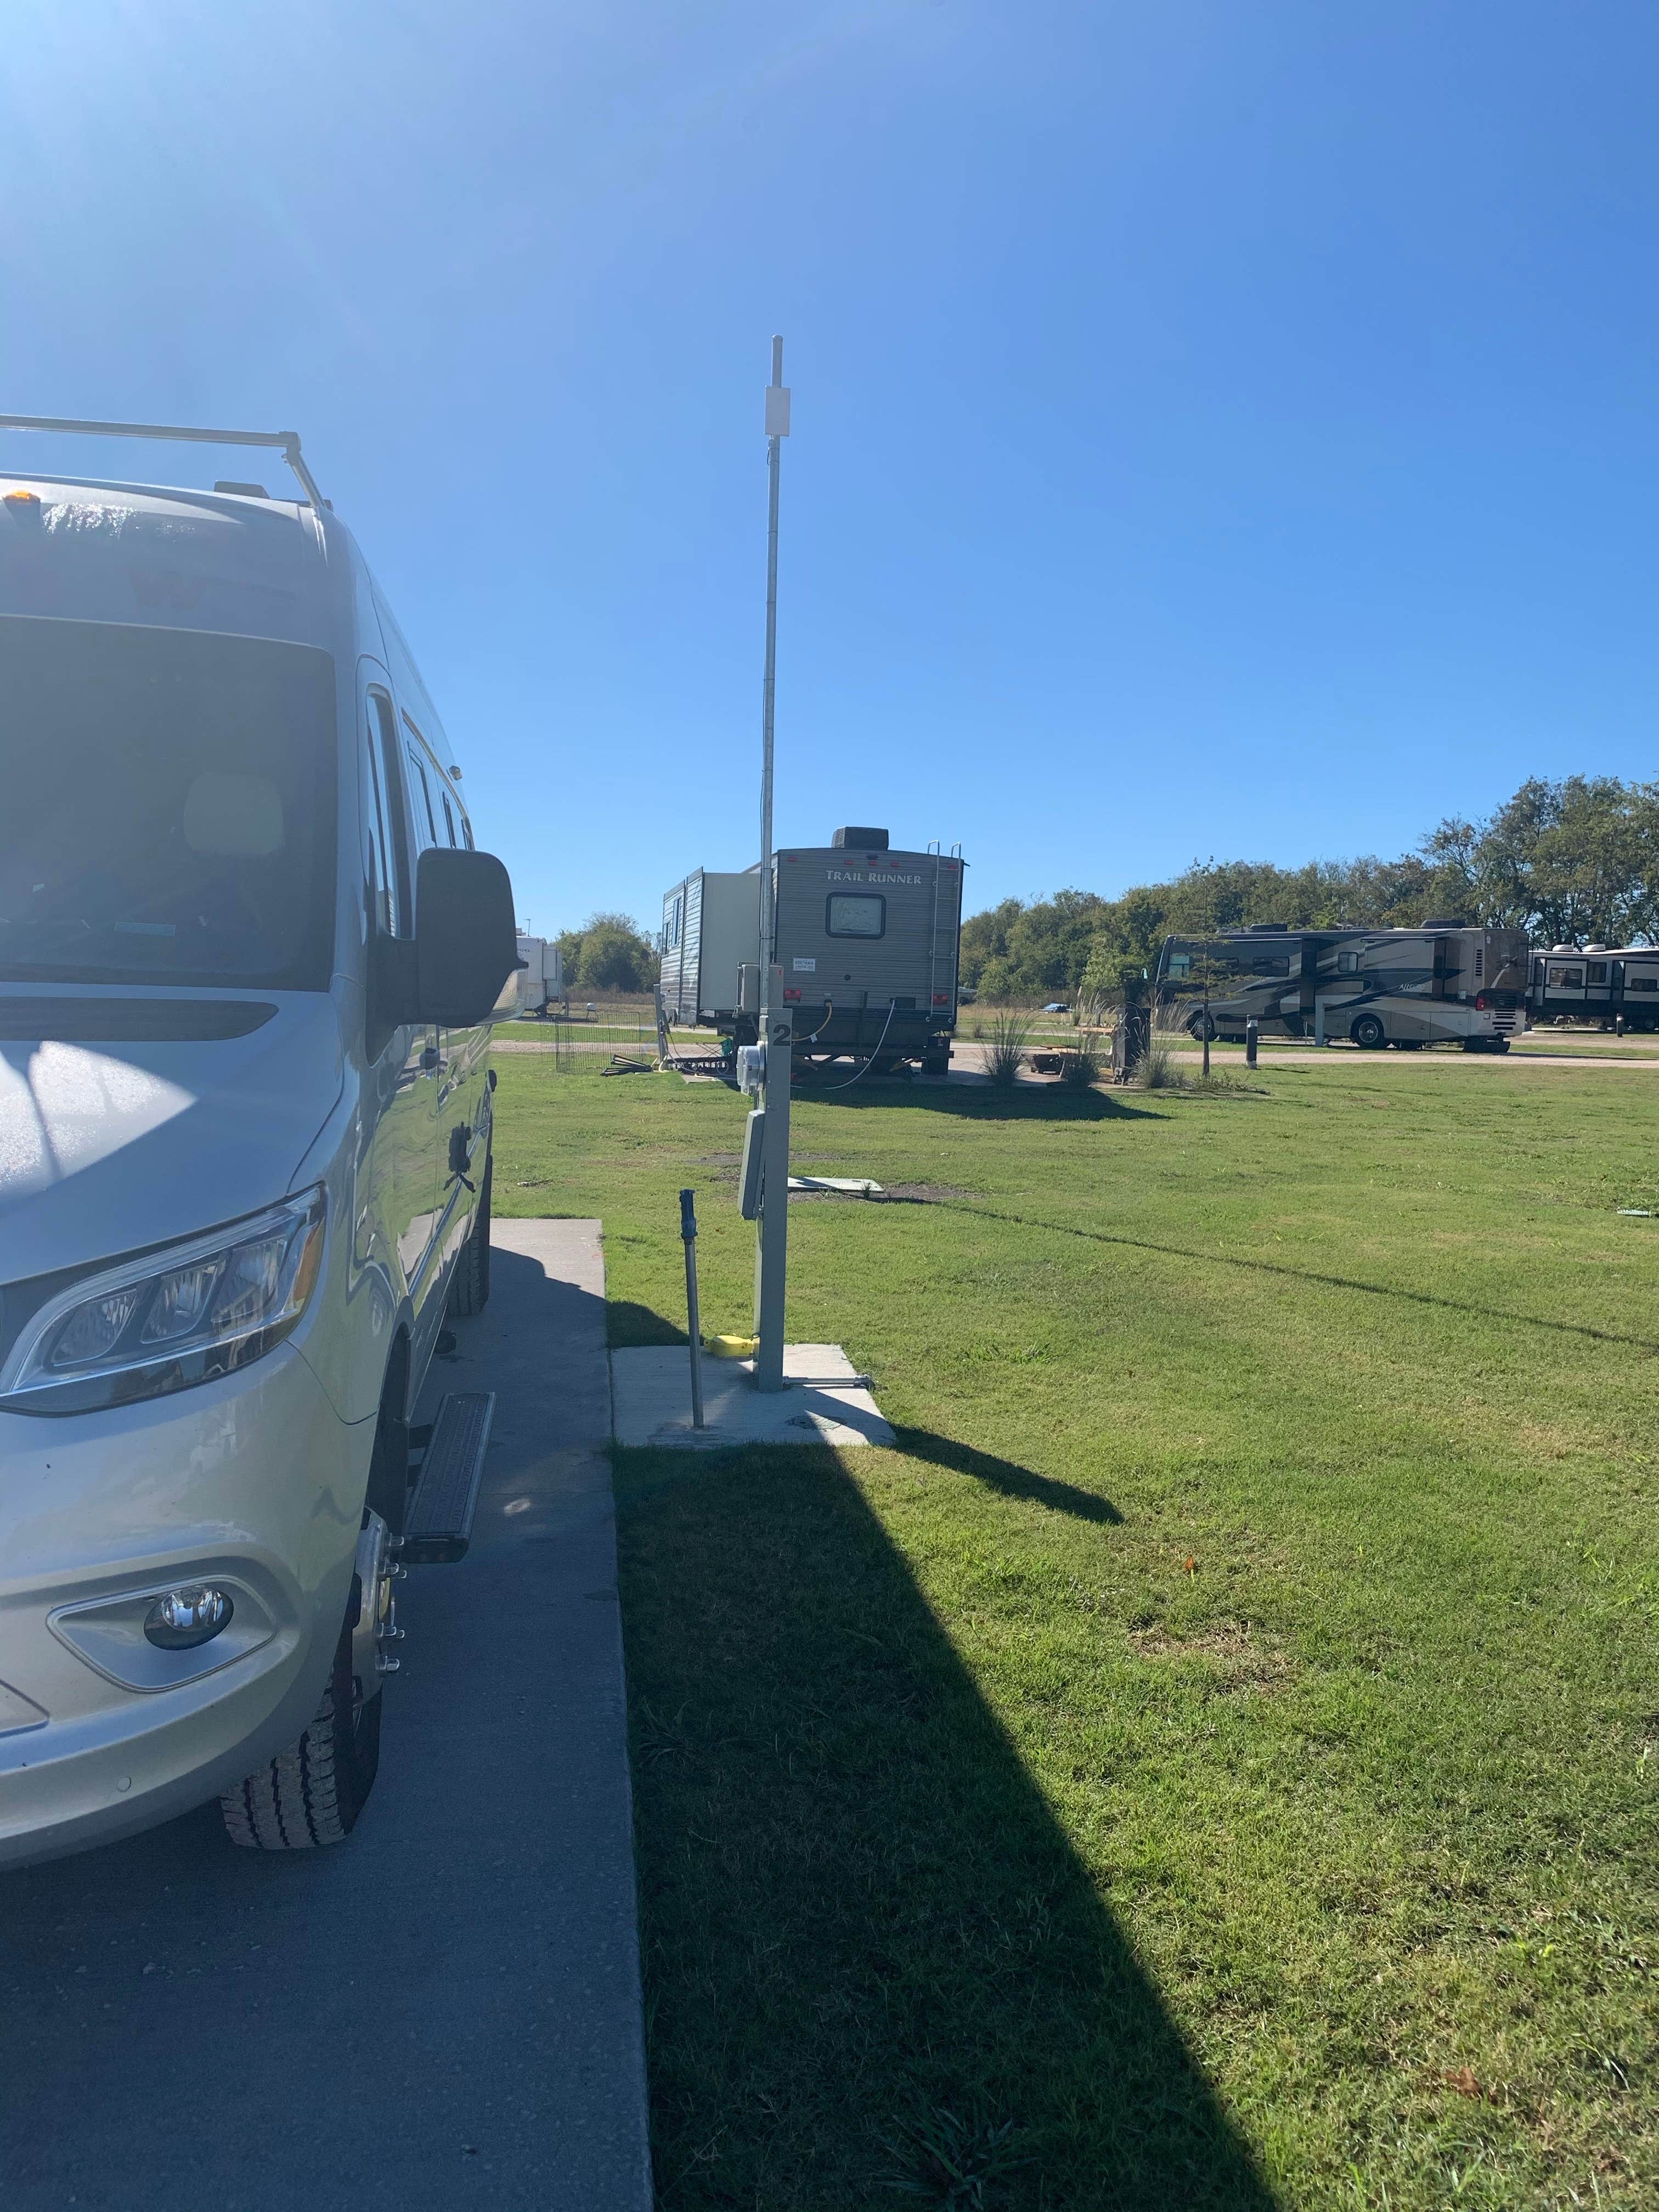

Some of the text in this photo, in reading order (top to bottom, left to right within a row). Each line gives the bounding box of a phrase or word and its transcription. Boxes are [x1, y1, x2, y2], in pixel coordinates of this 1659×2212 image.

[826, 870, 921, 884] TRAIL RUNNER
[772, 1024, 791, 1046] 2
